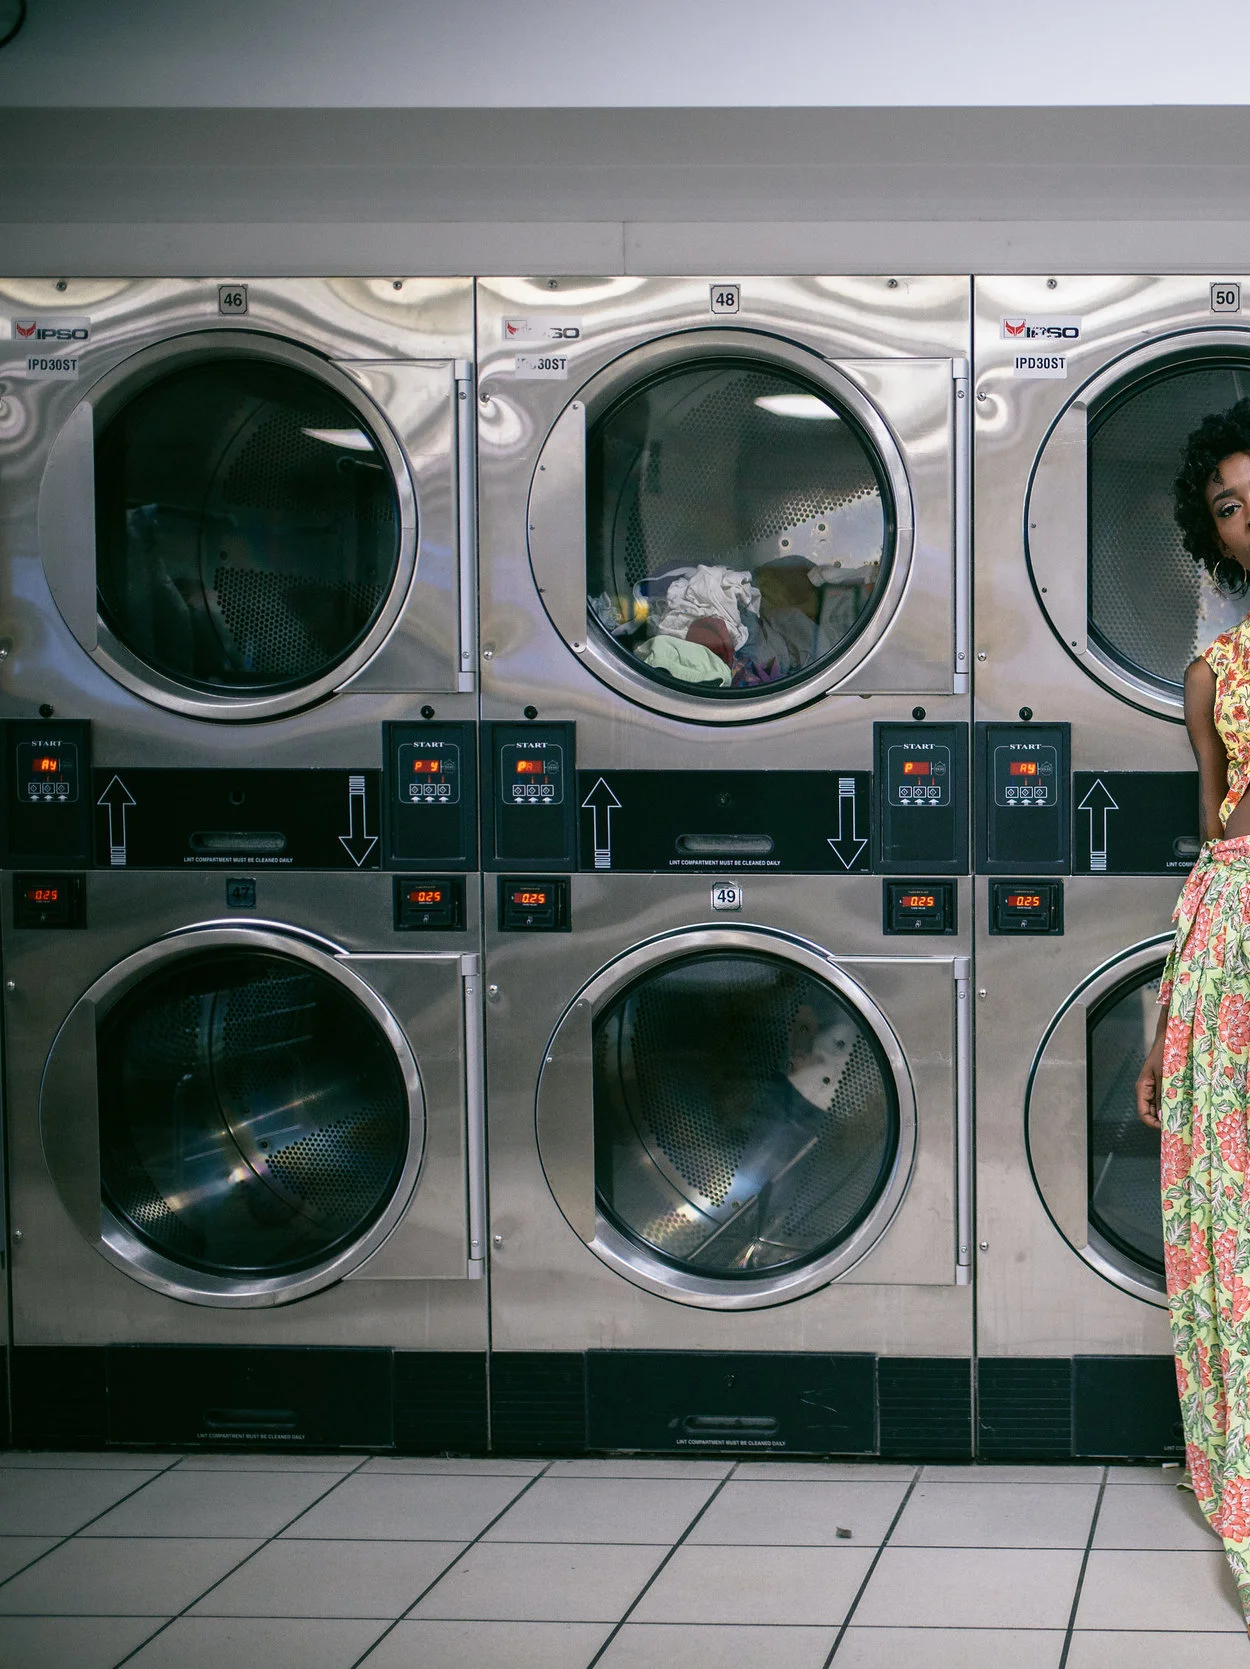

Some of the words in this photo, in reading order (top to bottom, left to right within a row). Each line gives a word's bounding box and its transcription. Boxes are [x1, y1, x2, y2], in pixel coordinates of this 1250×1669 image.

[223, 293, 243, 306] 46
[716, 293, 734, 306] 48
[1216, 291, 1235, 304] 50
[36, 328, 88, 340] IPSO
[28, 359, 77, 371] IPD30ST
[1015, 357, 1066, 369] IPD30ST
[232, 887, 250, 899] 47
[717, 889, 736, 903] 49
